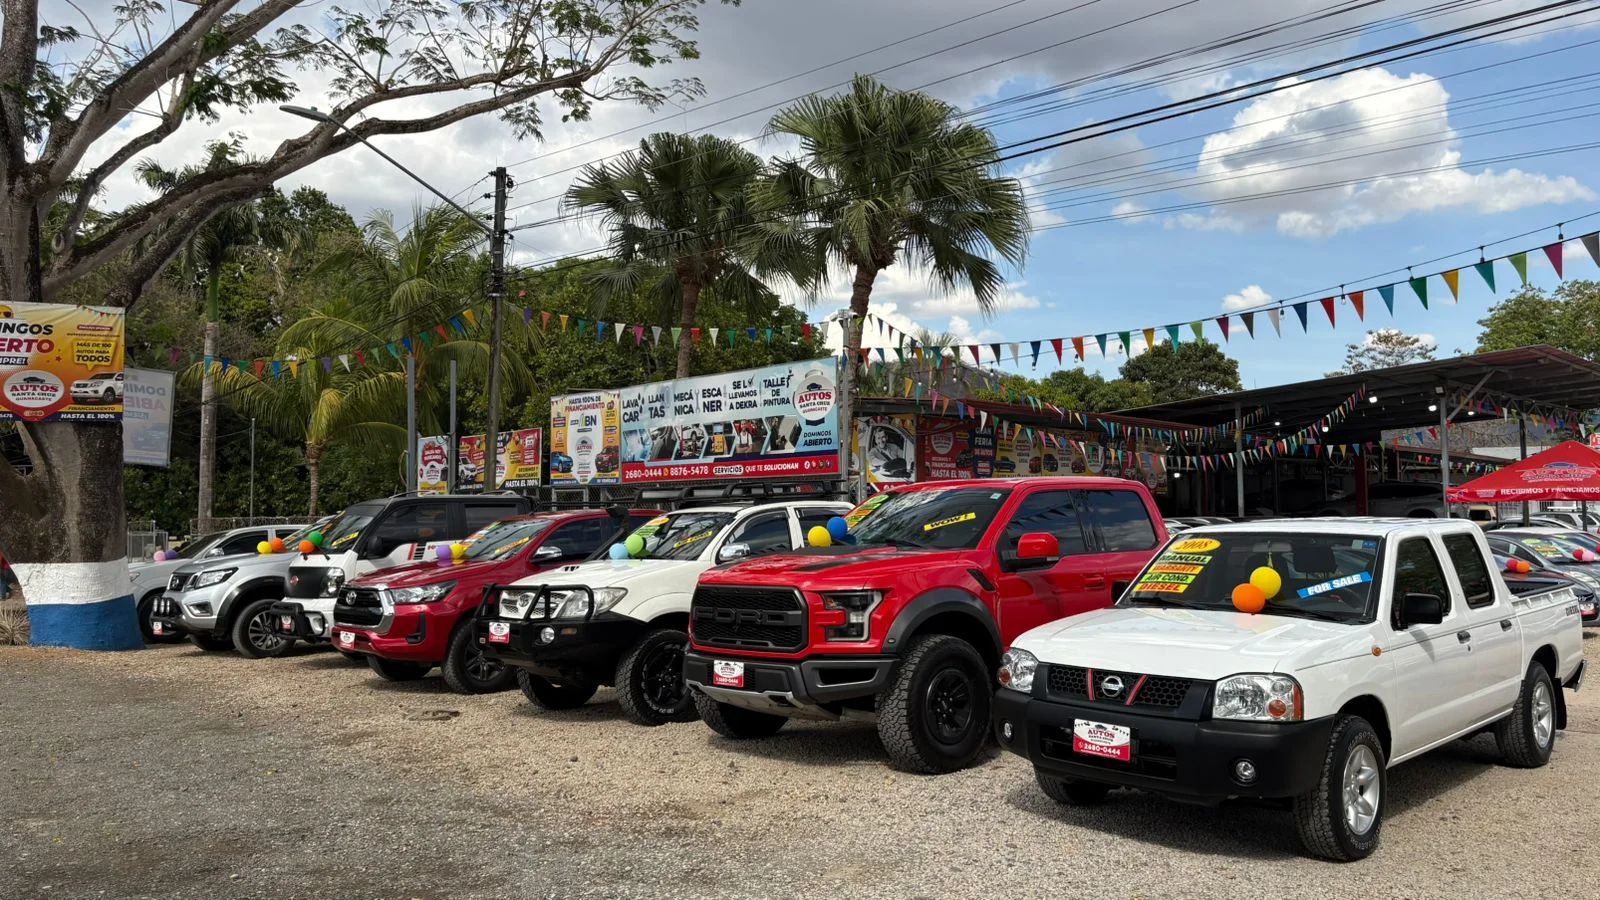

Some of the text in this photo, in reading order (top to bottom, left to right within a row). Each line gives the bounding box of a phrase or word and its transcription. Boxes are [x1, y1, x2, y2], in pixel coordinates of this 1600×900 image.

[76, 354, 111, 363] TODOS
[10, 384, 59, 393] AUTOS
[732, 380, 742, 390] SE
[674, 389, 694, 402] MECÁ
[702, 387, 722, 398] ESCA
[728, 390, 757, 400] LLEVAMOS
[771, 389, 780, 397] DE
[798, 391, 832, 404] AUTOS
[569, 397, 582, 405] HASTA
[648, 393, 665, 403] LLAN
[763, 397, 791, 407] PINTURA
[565, 402, 605, 412] FINANCIAMIENTO
[622, 399, 639, 409] LAVA
[703, 400, 722, 413] NER
[729, 400, 757, 410] A DEKRA
[648, 406, 665, 419] TAS
[674, 404, 694, 416] NICA
[585, 415, 597, 426] BN
[622, 412, 640, 423] CAR
[803, 430, 832, 438] DOMINGOS
[803, 437, 833, 447] ABIERTO
[974, 437, 993, 446] FERIA
[625, 468, 662, 479] 2680-0444
[670, 466, 709, 476] 8876-5478
[714, 465, 742, 474] SERVICIOS
[763, 463, 799, 471] SOLUCIONAN
[931, 469, 950, 478] HASTA
[951, 470, 957, 478] EL
[505, 480, 519, 488] HASTA
[930, 516, 961, 528] WOW
[1140, 583, 1180, 591] DIESEL
[1307, 574, 1363, 596] FOR SALE
[694, 606, 790, 626] FORD
[1087, 729, 1116, 739] AUTOS
[1084, 743, 1121, 756] 2680-0444
